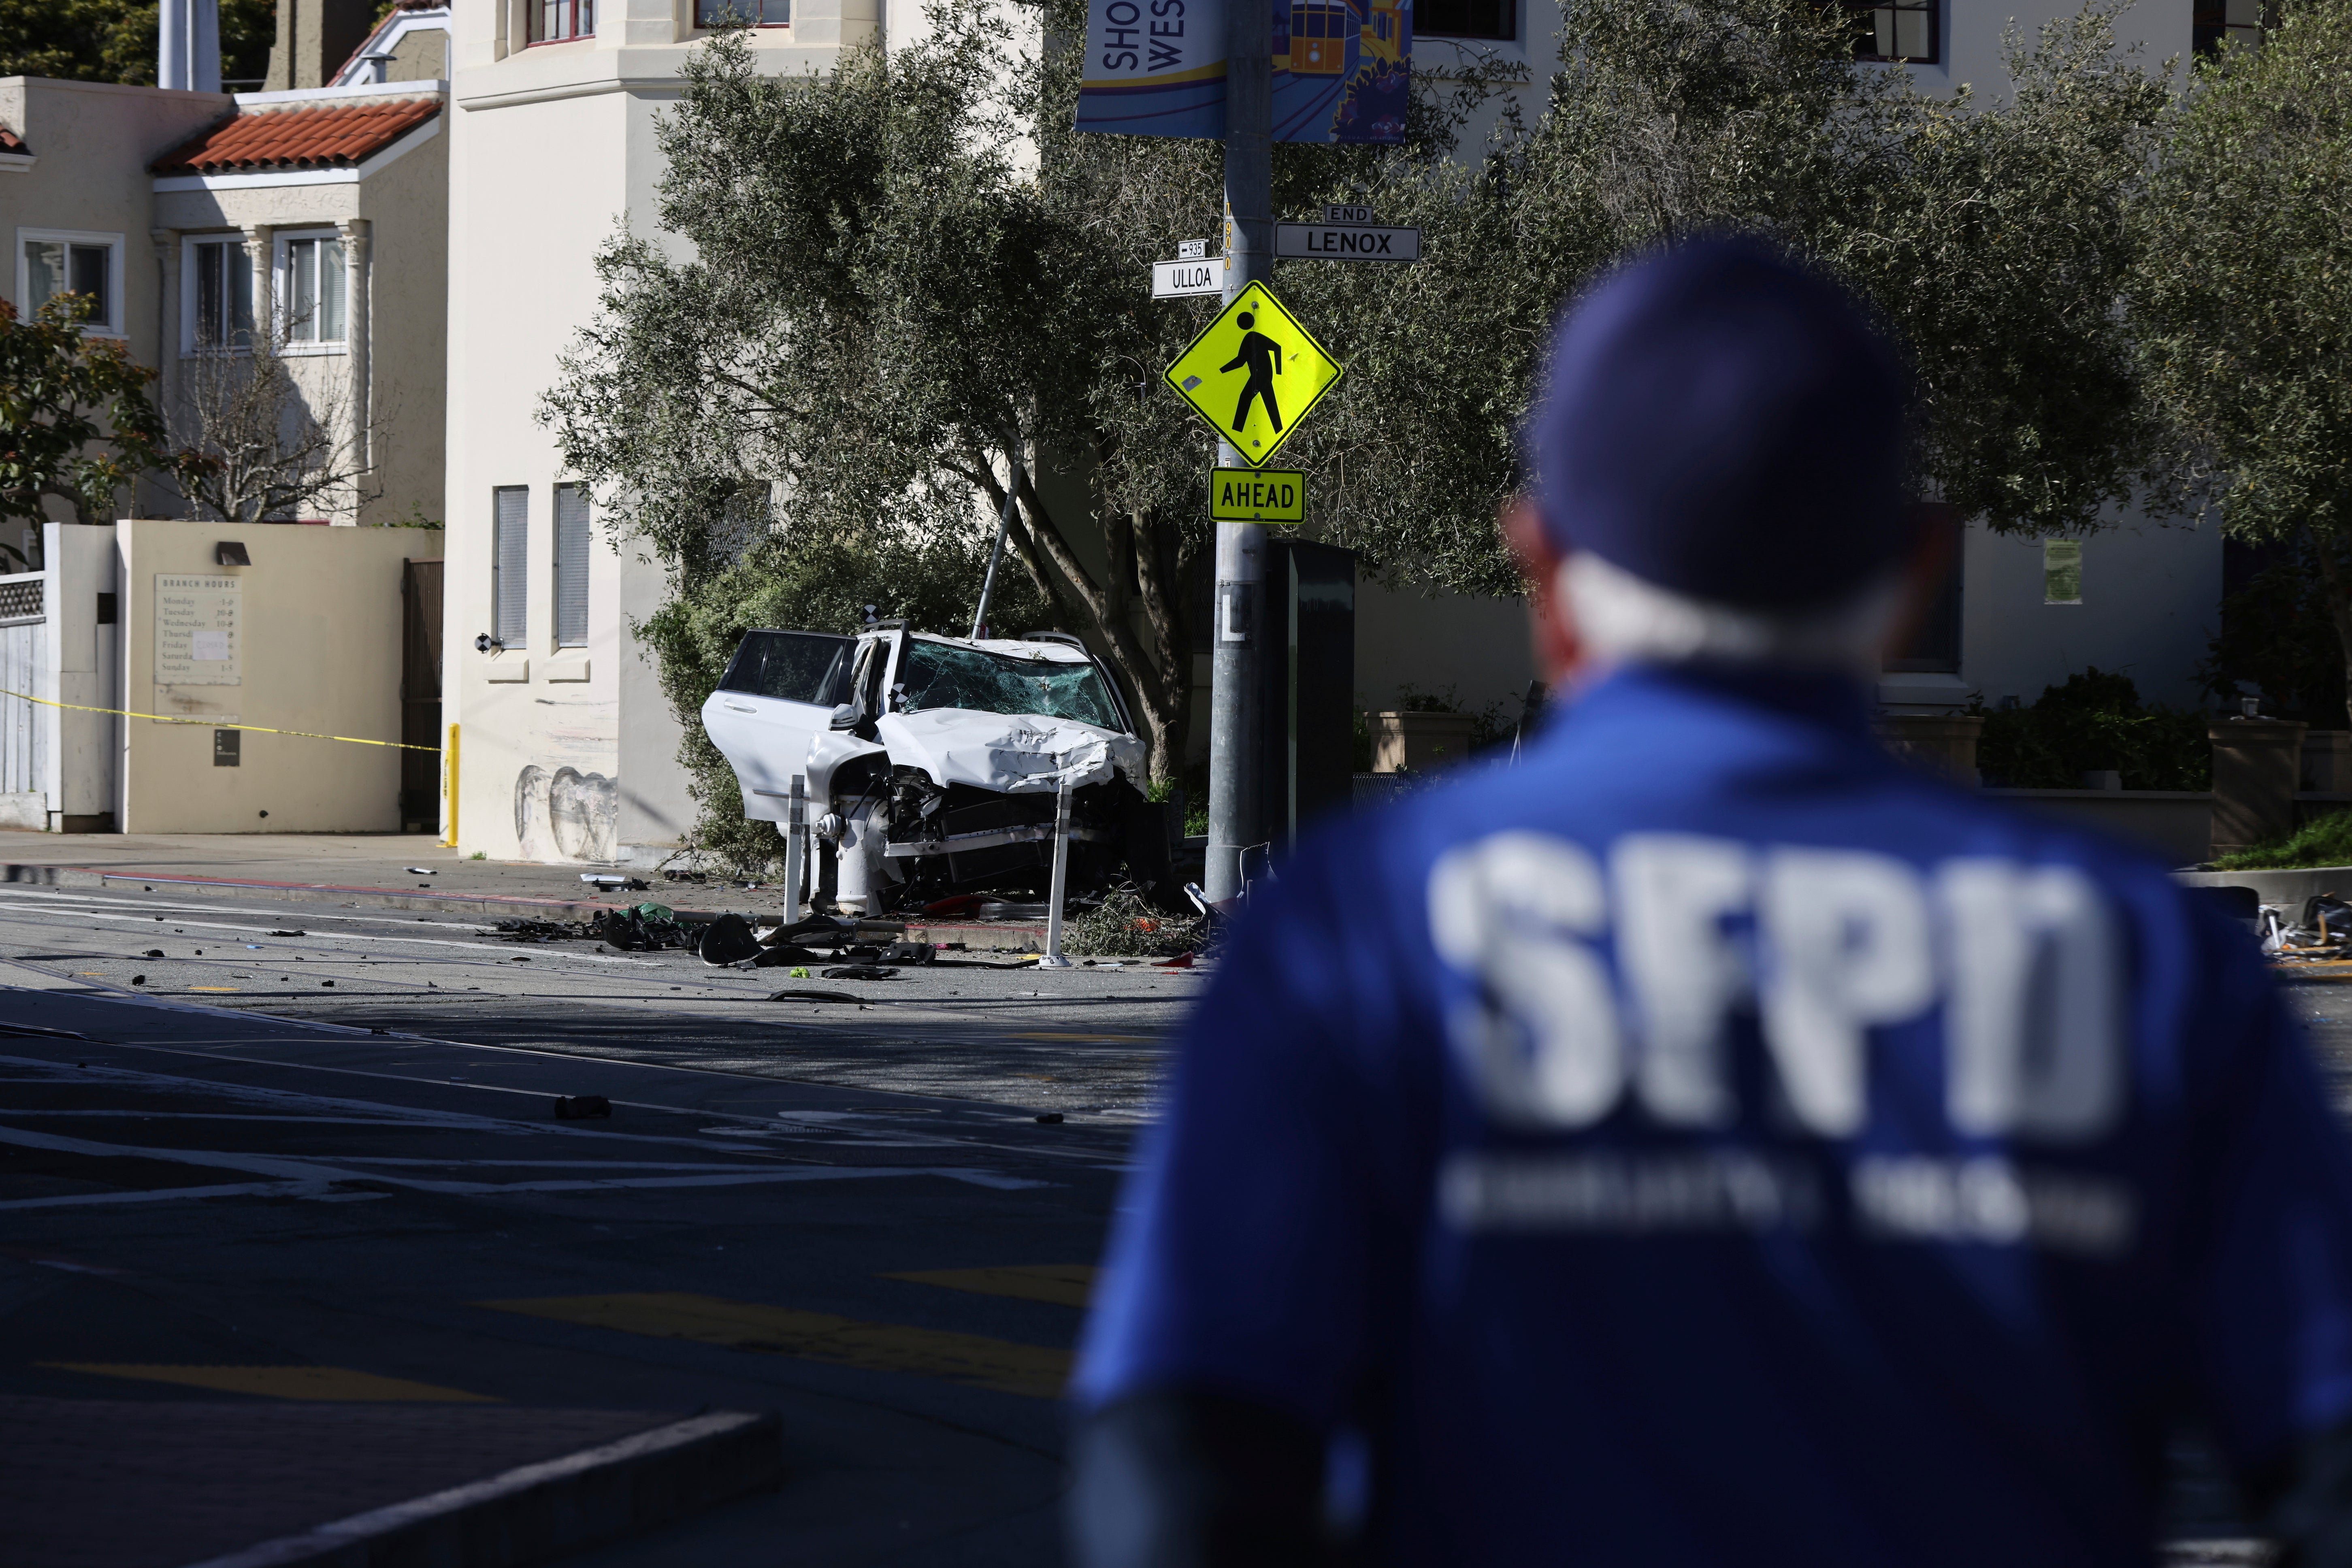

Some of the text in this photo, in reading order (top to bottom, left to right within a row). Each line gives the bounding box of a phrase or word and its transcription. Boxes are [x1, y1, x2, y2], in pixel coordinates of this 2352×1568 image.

[1331, 208, 1367, 221] END
[1308, 232, 1391, 254] LENOX
[1189, 244, 1202, 256] 935
[1173, 267, 1211, 288] ULLOA
[1221, 482, 1293, 508] AHEAD
[164, 608, 194, 617] Tuesday
[164, 620, 205, 628] Wednesday
[163, 641, 187, 650] Friday
[162, 664, 190, 672] Sunday
[1427, 830, 2124, 1142] SFPD
